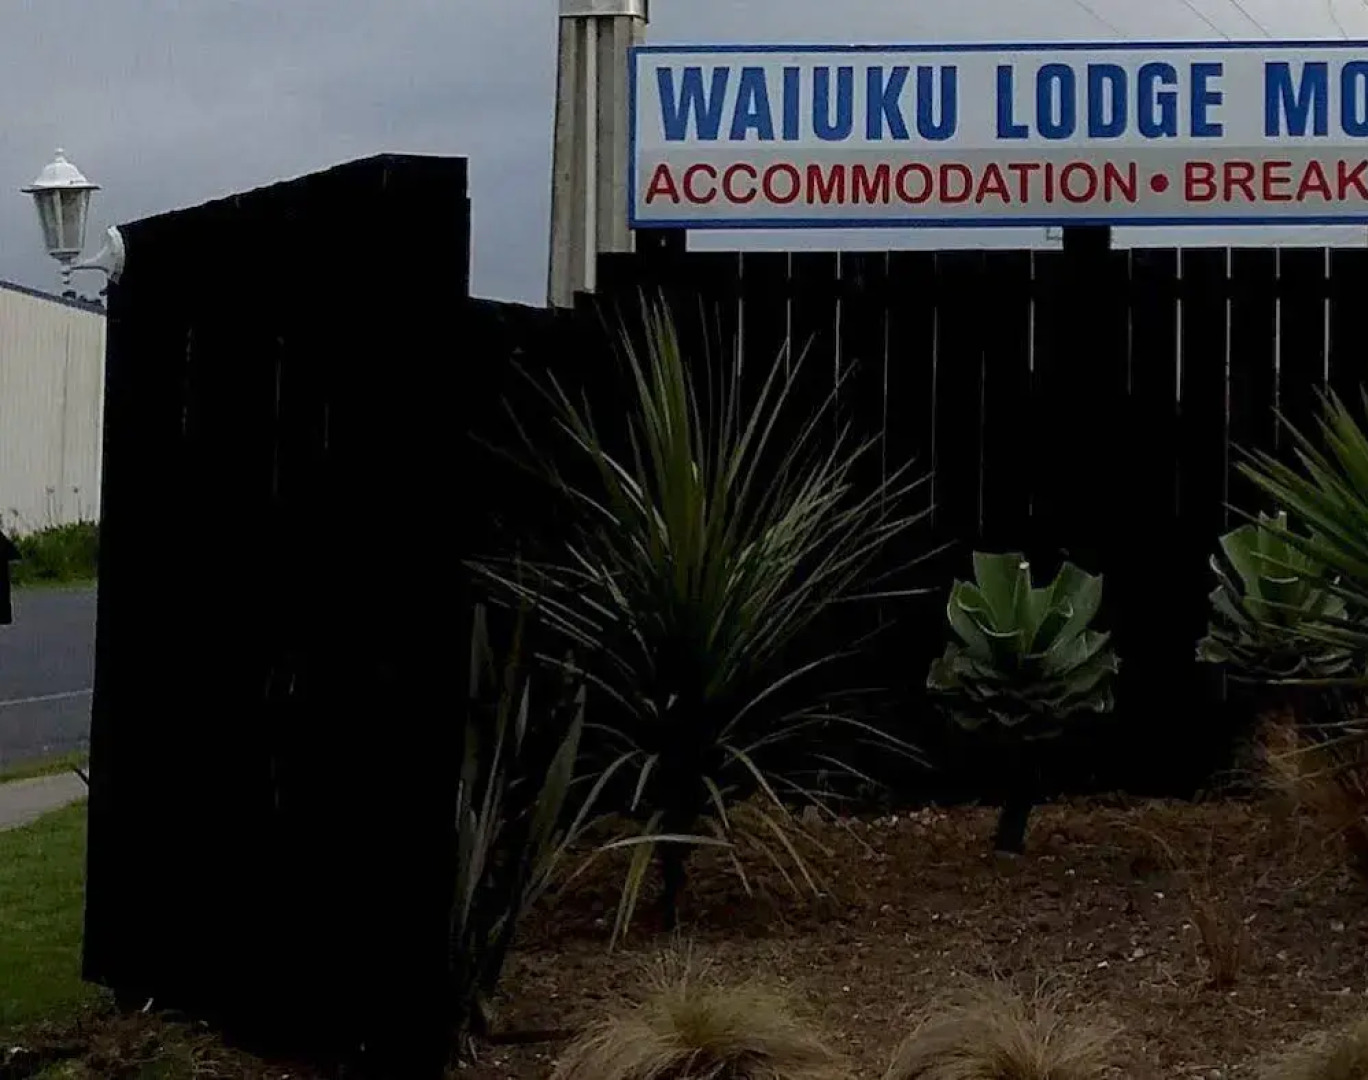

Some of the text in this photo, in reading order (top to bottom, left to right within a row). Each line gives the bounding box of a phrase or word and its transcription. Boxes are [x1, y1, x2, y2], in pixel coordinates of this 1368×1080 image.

[655, 65, 958, 142] WAIUKU
[995, 62, 1224, 140] LODGE
[644, 161, 1137, 205] ACCOMMODATION
